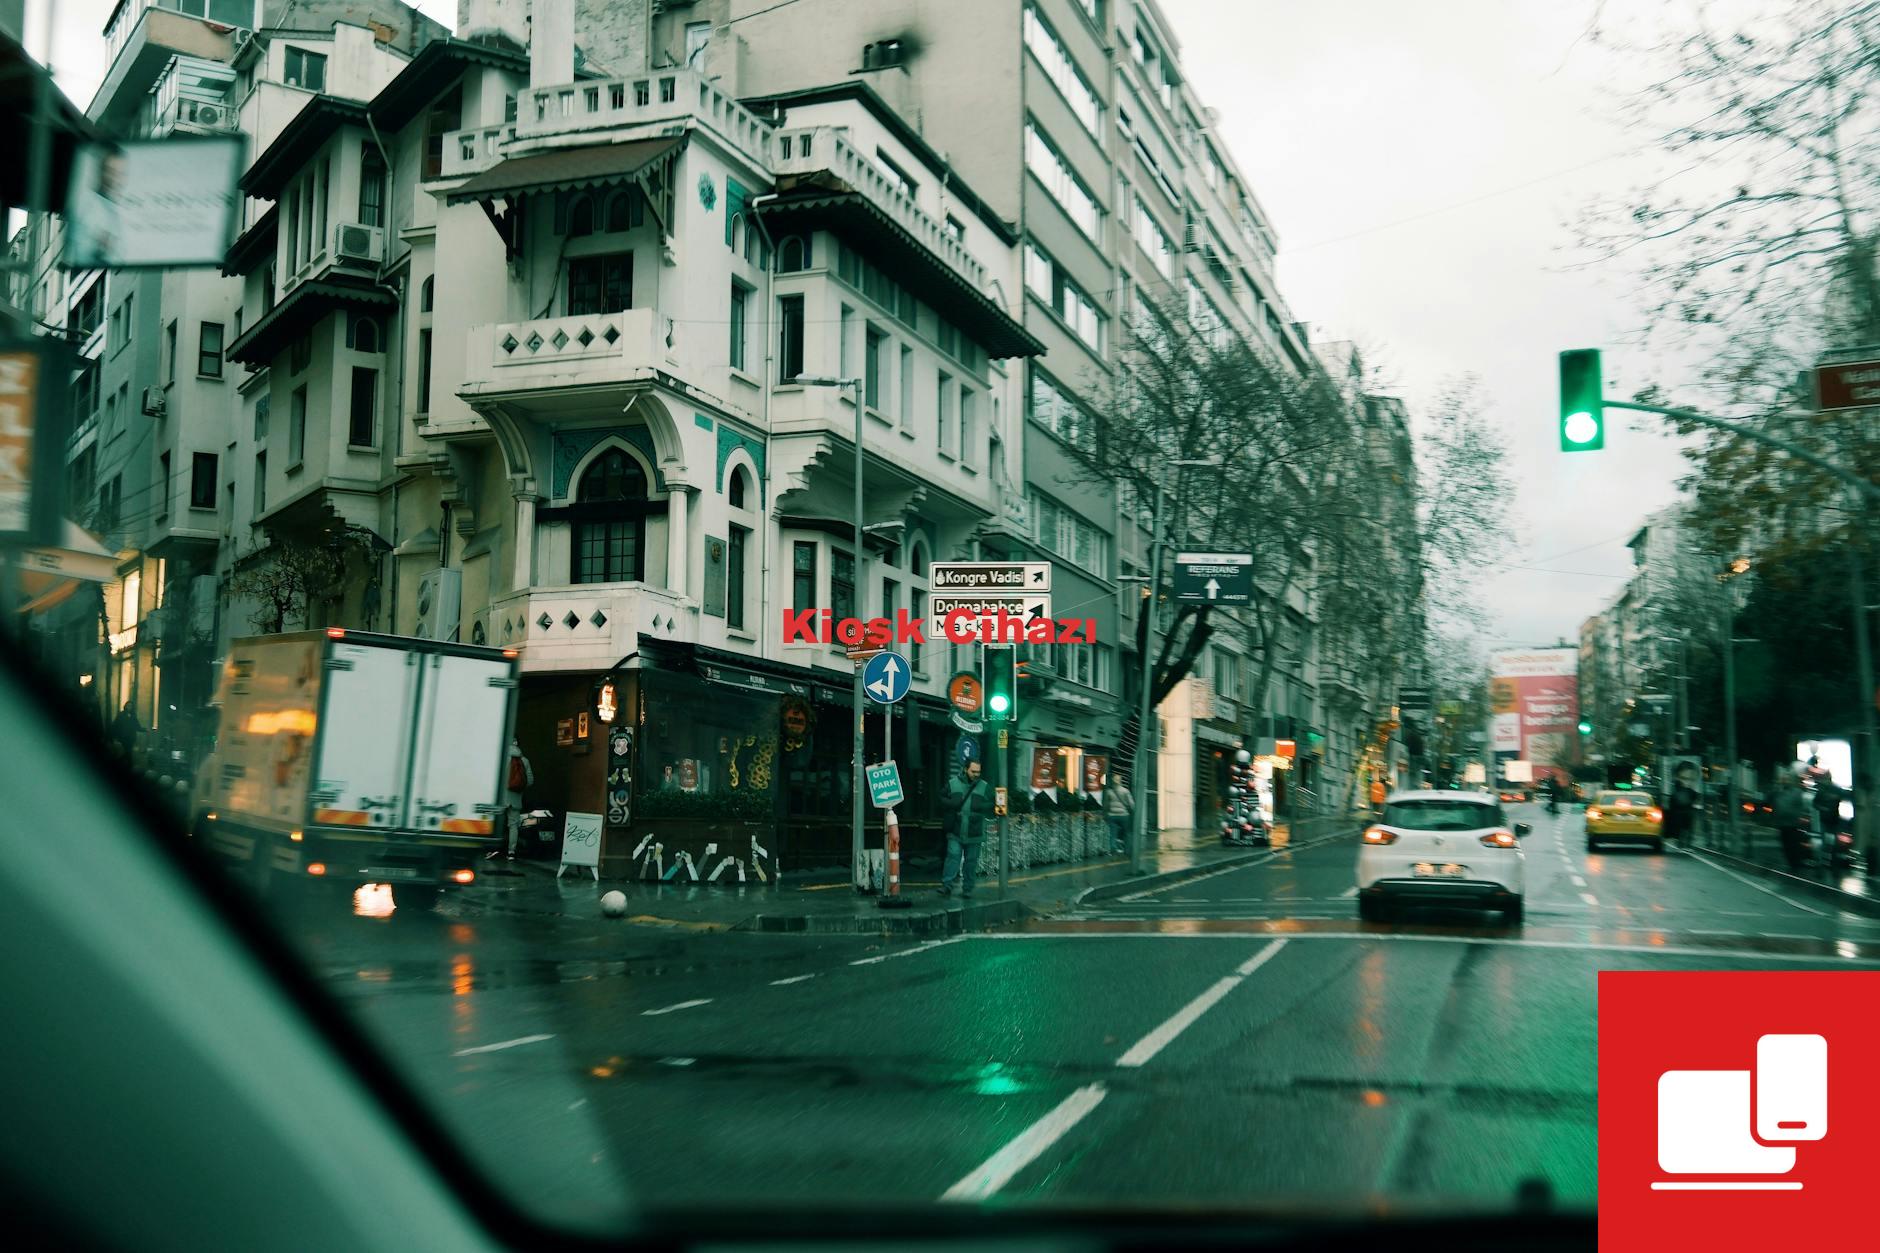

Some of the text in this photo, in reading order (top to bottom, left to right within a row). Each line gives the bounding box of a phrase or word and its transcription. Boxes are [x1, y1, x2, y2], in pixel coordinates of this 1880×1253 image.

[945, 570, 1024, 586] Kongre Vadisi
[872, 768, 891, 778] OTO
[872, 778, 897, 790] PARK
